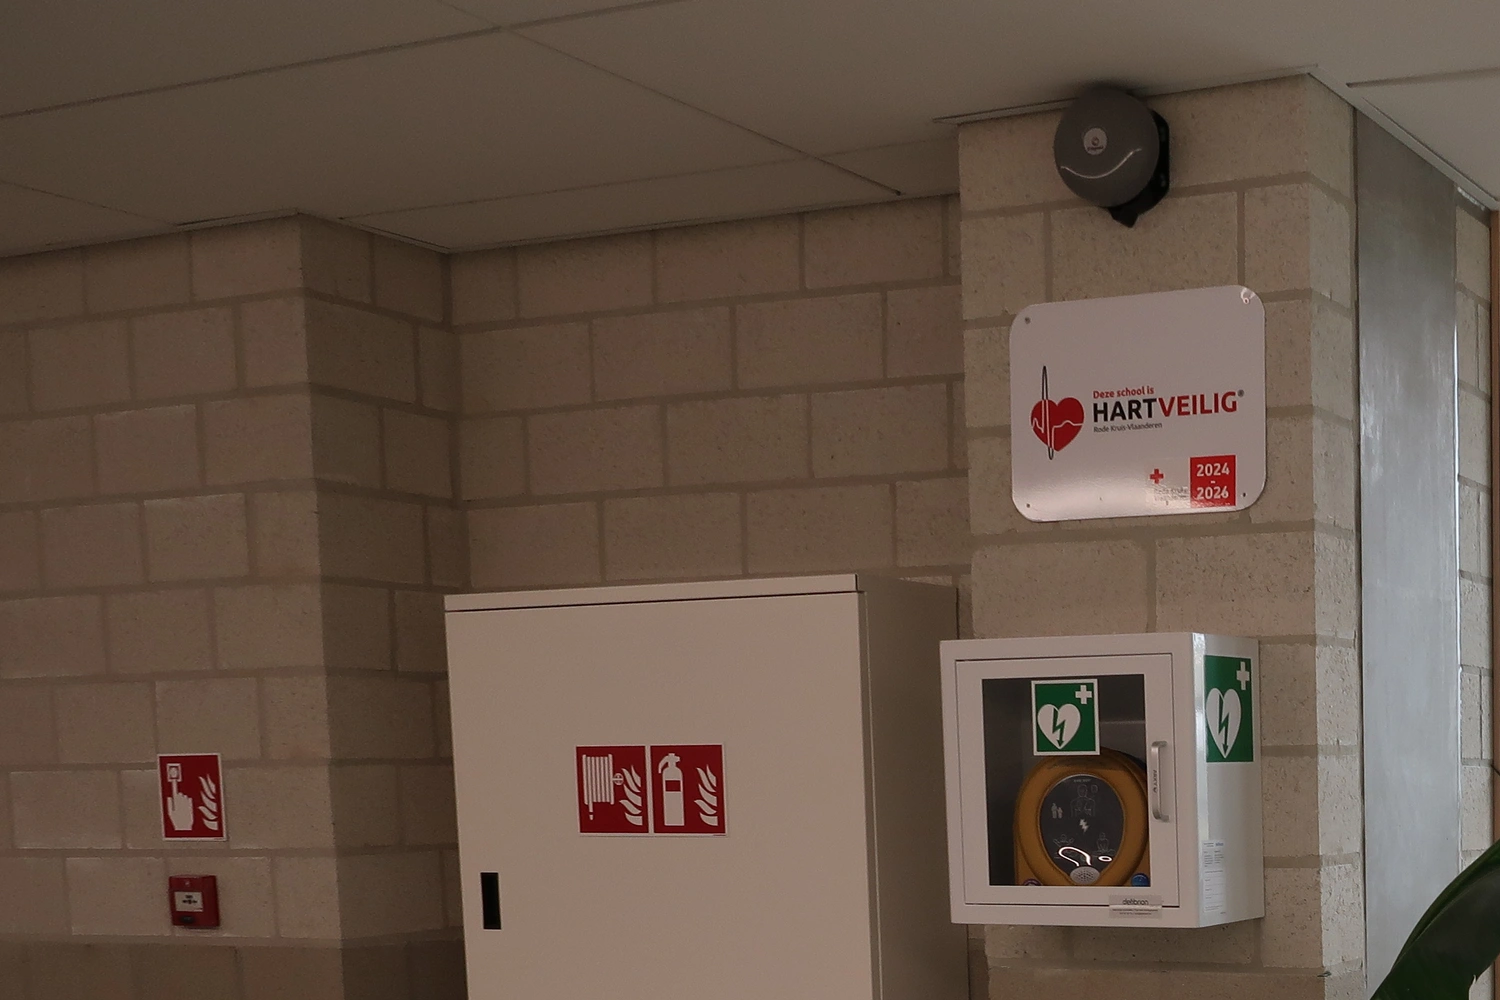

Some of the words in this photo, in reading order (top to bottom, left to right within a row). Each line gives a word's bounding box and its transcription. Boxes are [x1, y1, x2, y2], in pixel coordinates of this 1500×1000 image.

[1093, 390, 1114, 399] Deze
[1117, 386, 1145, 397] school
[1147, 386, 1154, 394] is
[1111, 422, 1163, 432] Kruis-Vlaanderen
[1196, 462, 1230, 477] 2024
[1196, 485, 1229, 500] 2026
